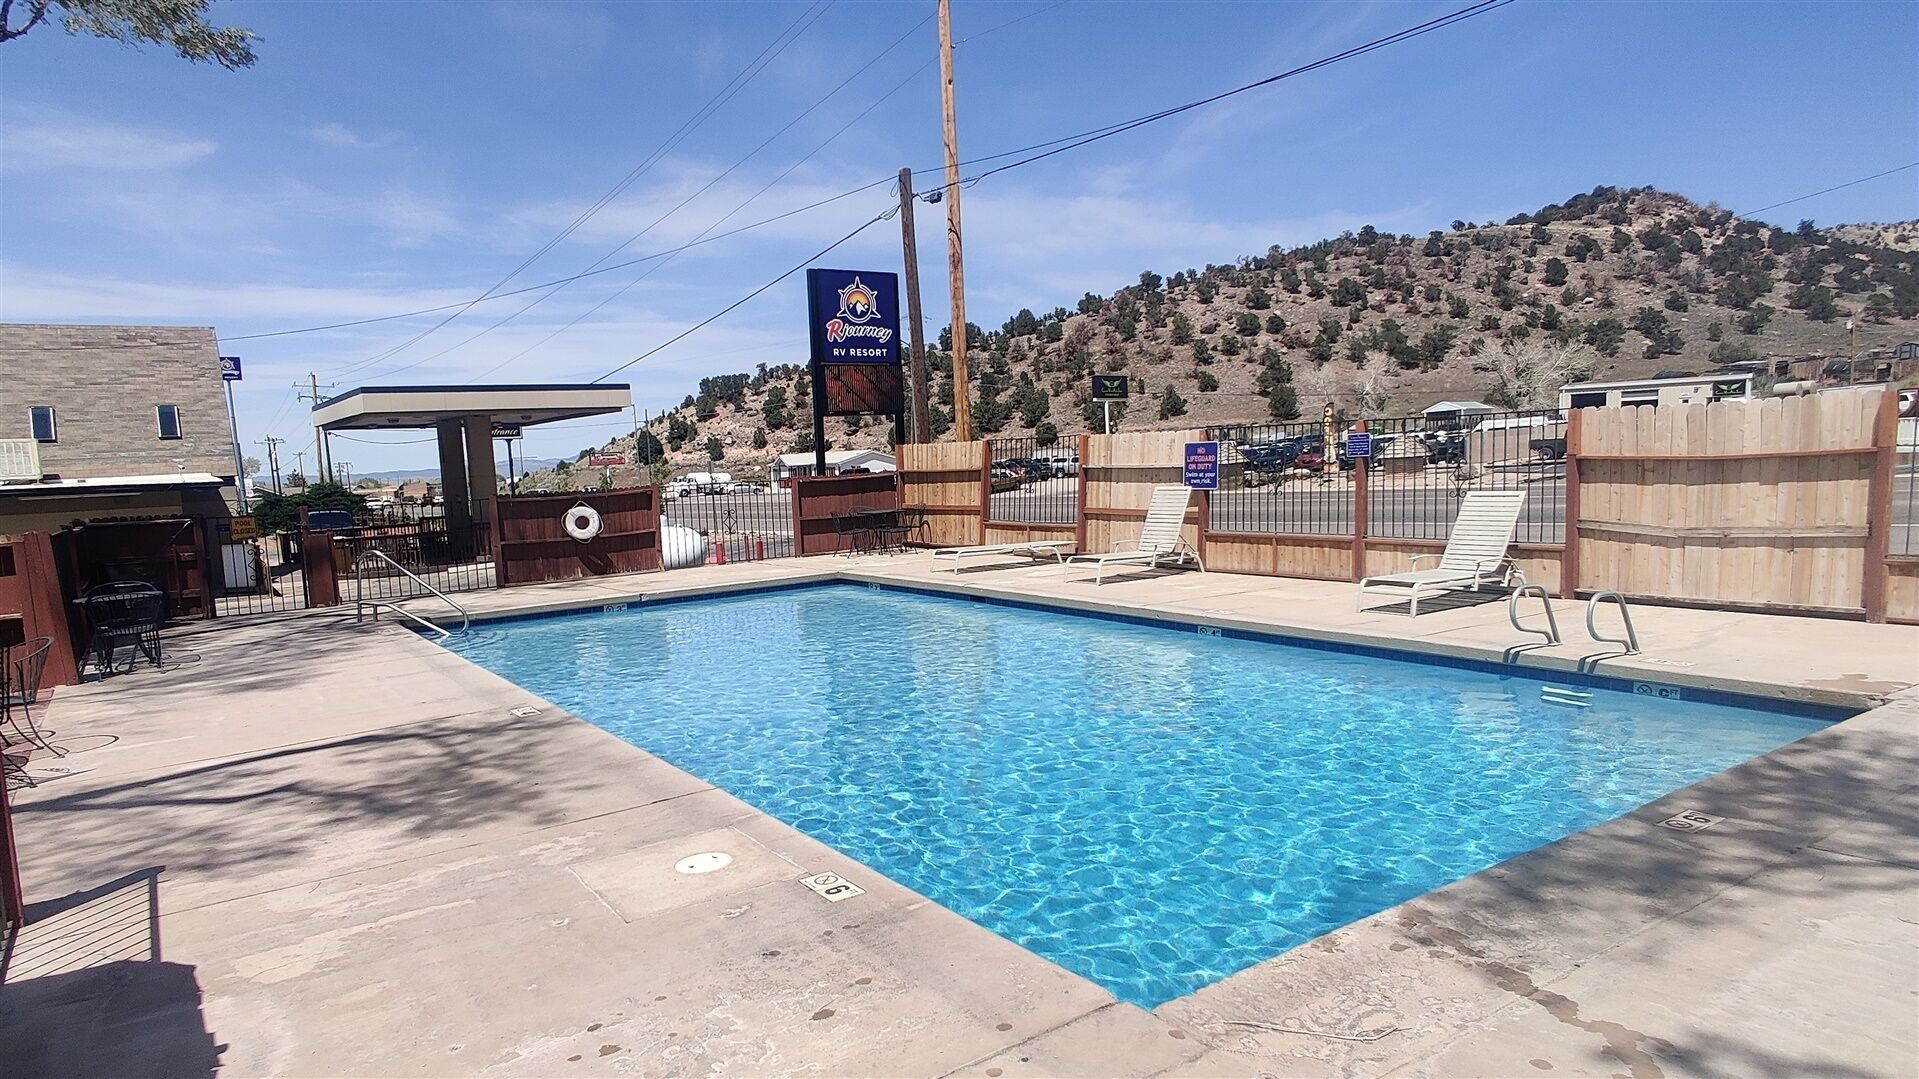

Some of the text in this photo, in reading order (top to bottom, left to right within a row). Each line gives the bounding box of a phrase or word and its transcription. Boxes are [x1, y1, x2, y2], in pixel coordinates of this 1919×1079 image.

[826, 319, 893, 343] Rjourney
[833, 348, 888, 357] RV RESORT
